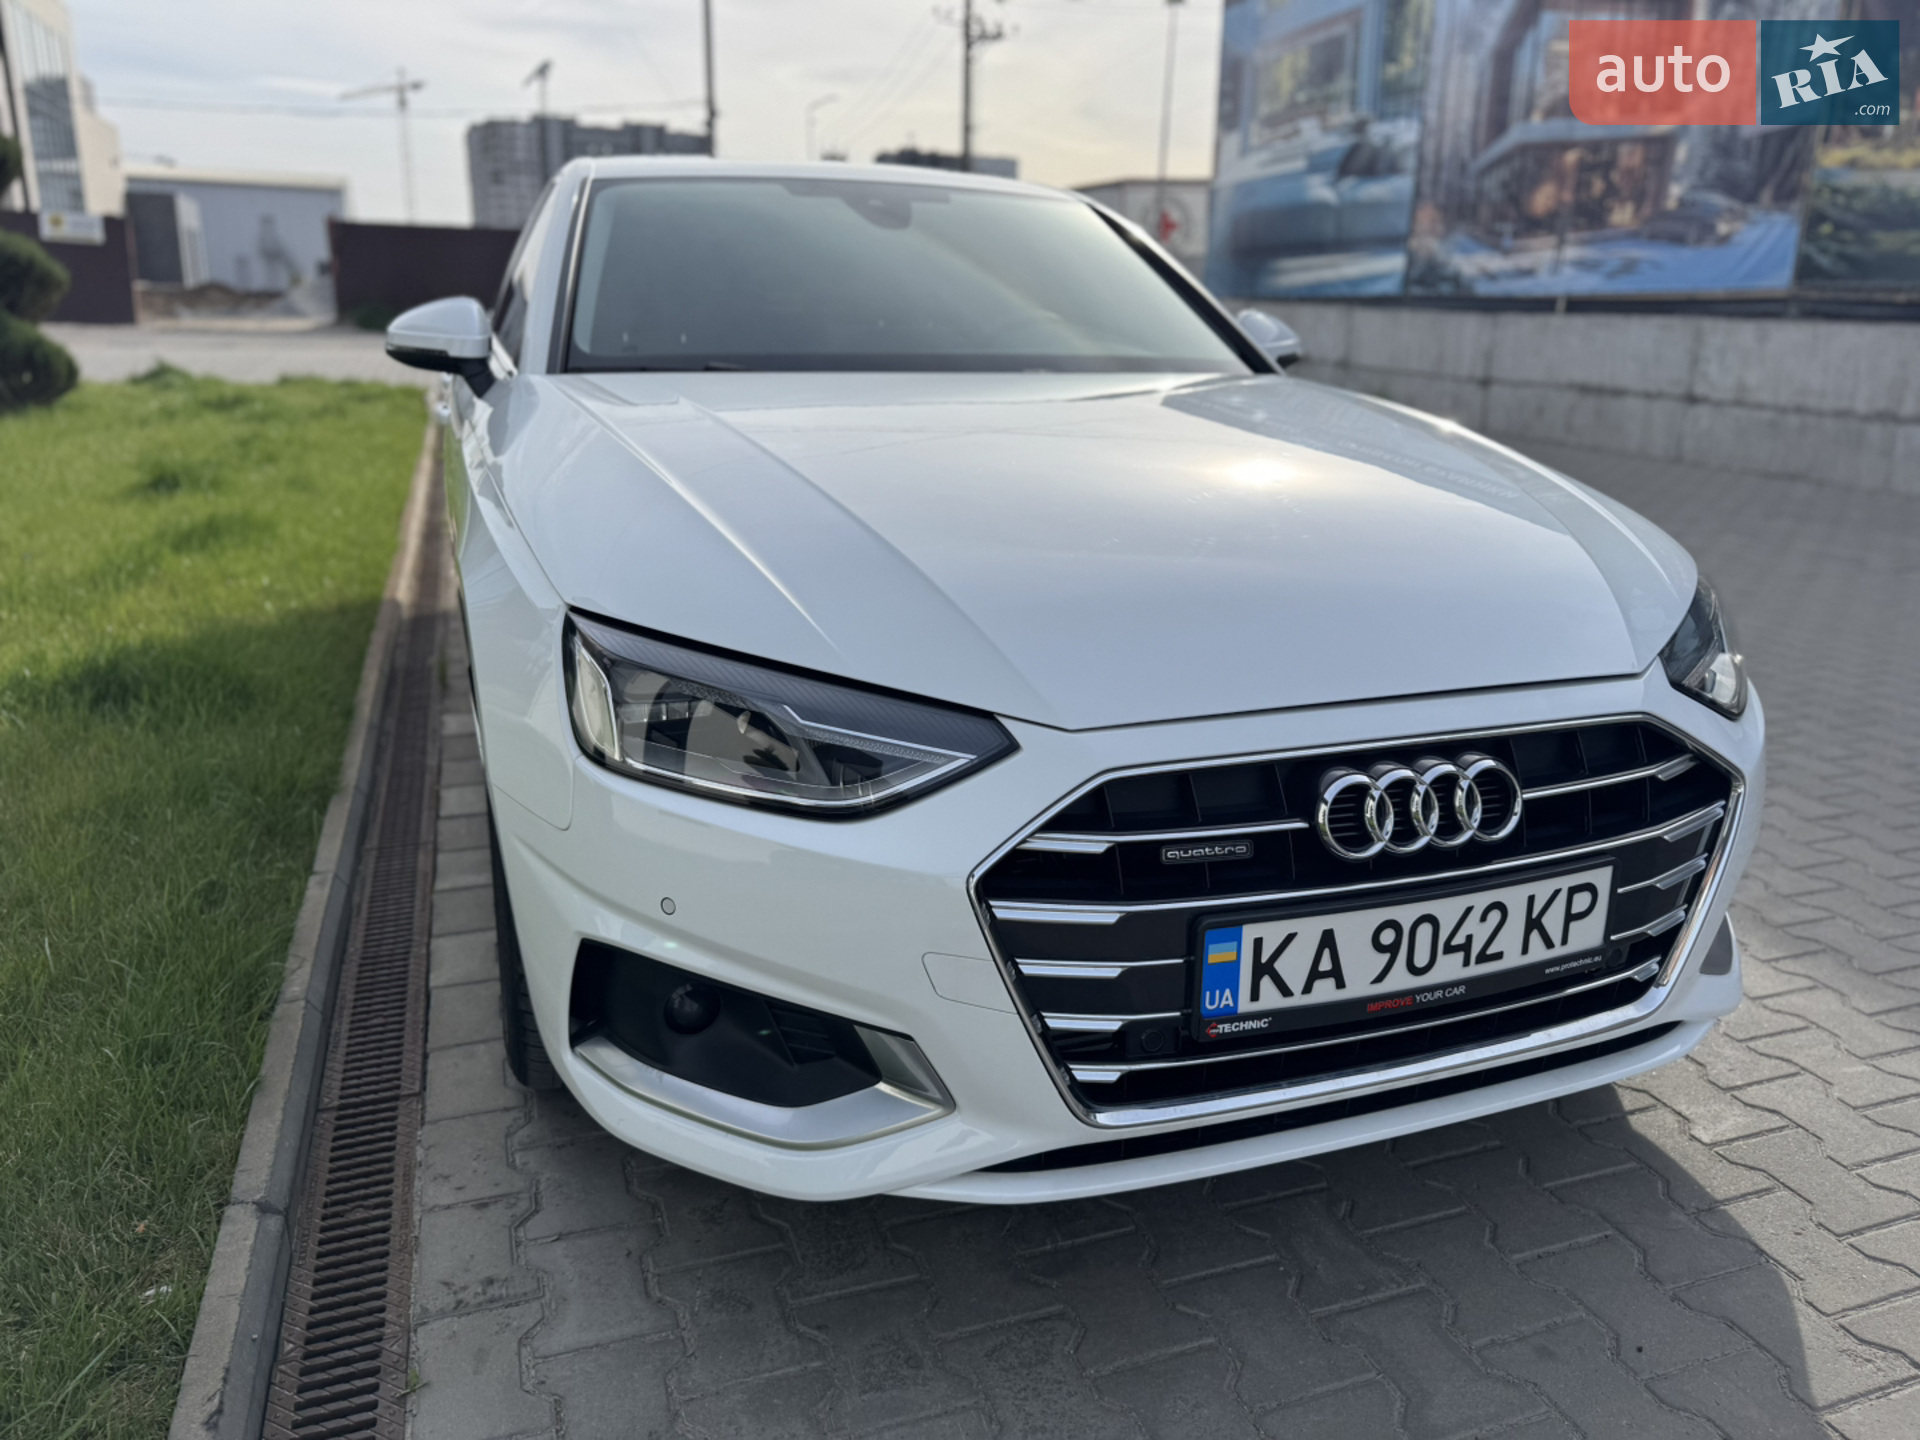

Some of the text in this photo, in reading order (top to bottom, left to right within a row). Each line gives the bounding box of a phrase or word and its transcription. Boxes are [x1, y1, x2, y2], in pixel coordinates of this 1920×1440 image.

[1167, 846, 1247, 860] quattro
[1249, 882, 1599, 1002] KA 9042 KP
[1205, 988, 1234, 1010] UA
[1367, 985, 1467, 1012] IMPROVE YOUR CAR
